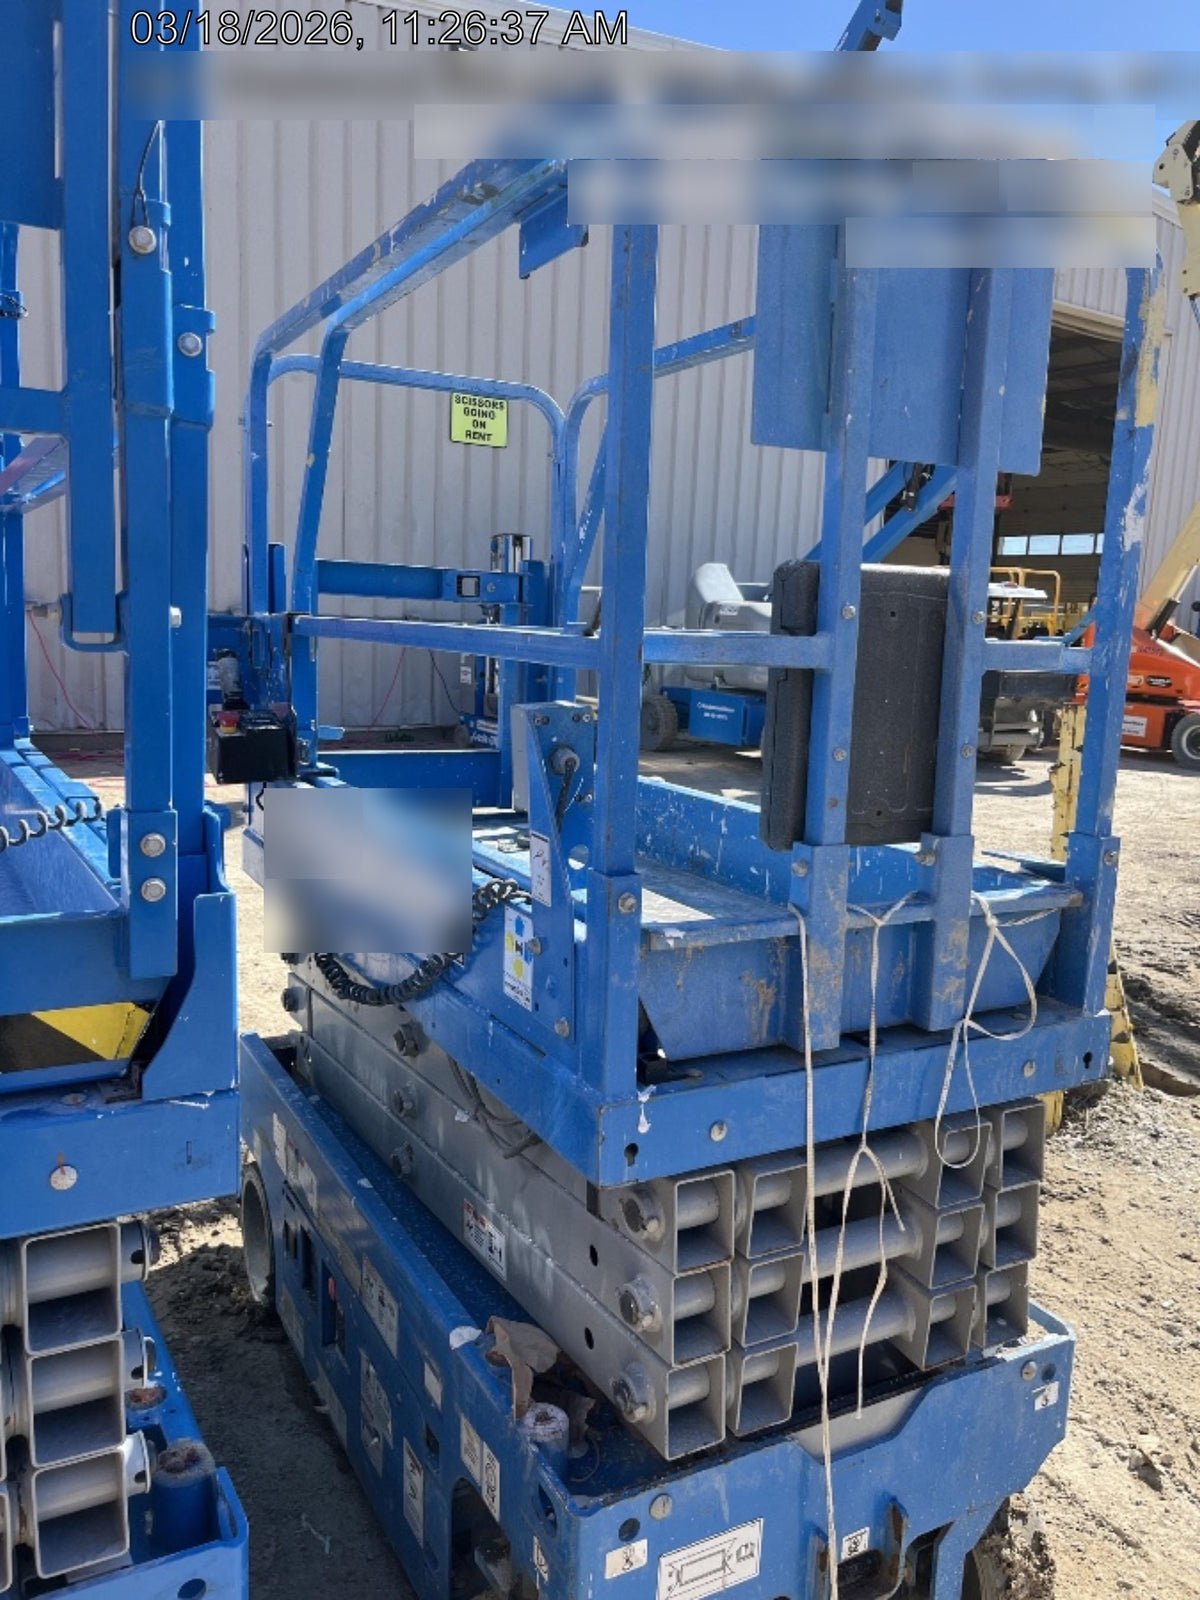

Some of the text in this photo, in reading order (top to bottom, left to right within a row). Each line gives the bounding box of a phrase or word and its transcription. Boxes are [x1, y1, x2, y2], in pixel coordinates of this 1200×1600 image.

[454, 394, 504, 410] SCISSORS
[463, 406, 495, 420] GOING
[472, 419, 486, 429] ON
[465, 430, 492, 441] RENT
